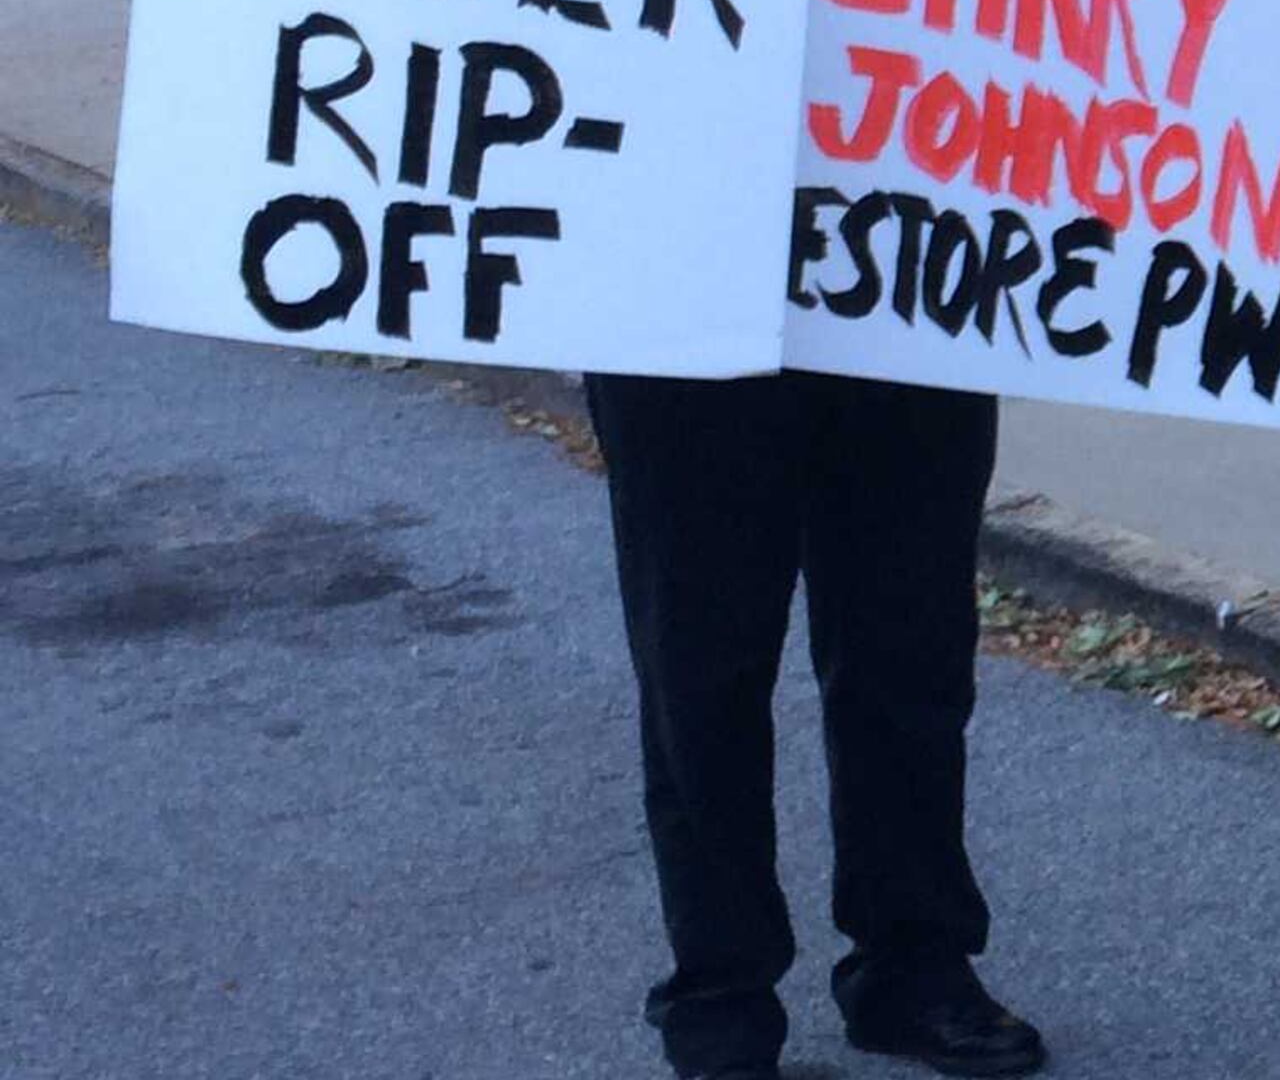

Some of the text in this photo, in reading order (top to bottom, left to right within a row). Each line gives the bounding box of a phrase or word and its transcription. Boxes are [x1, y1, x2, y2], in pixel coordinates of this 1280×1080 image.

[266, 11, 625, 201] RIP-
[239, 192, 561, 344] OFF
[786, 186, 1115, 362] ESTORE
